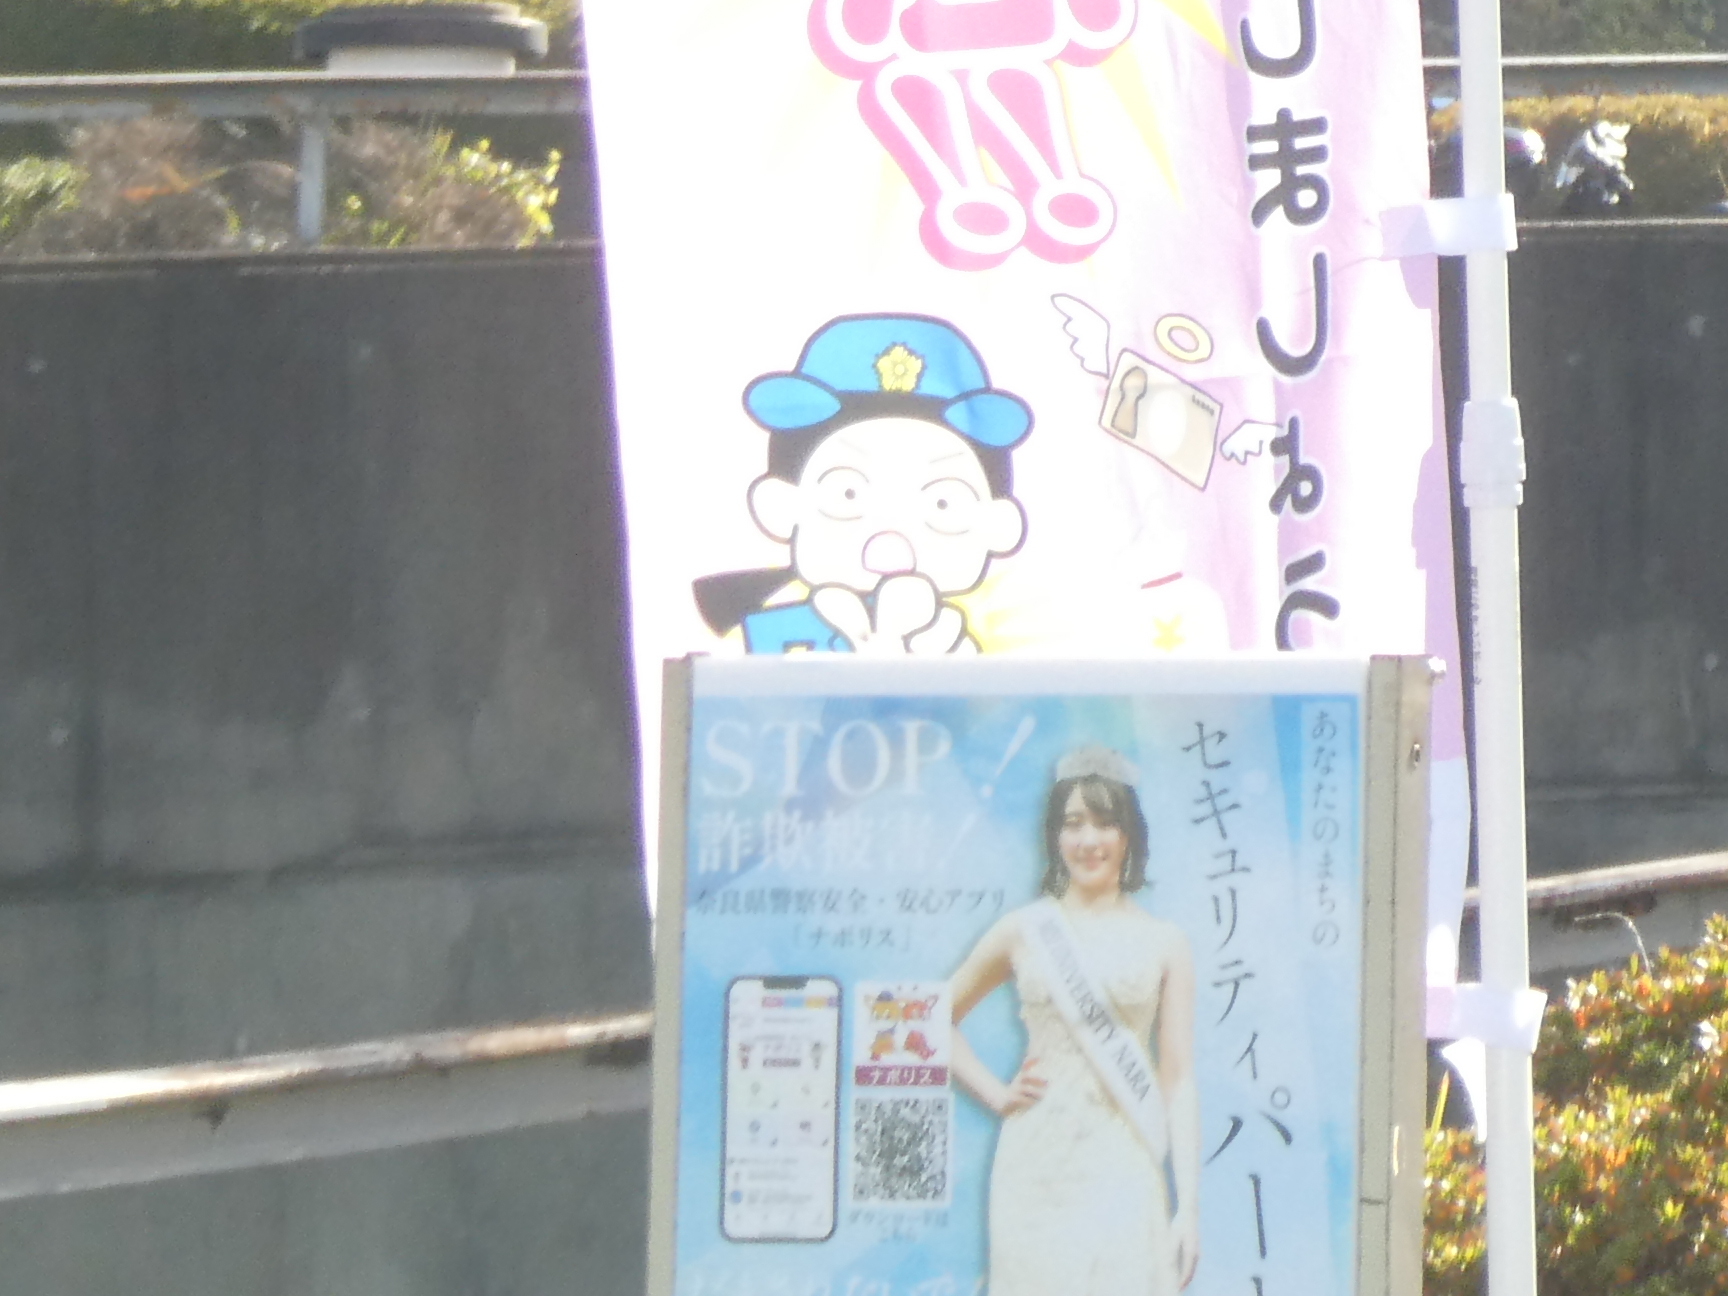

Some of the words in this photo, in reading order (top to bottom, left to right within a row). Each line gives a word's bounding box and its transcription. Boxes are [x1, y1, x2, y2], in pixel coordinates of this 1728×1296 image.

[1311, 710, 1340, 949] あなたのまちの
[870, 1069, 932, 1085] ナポリス
[1114, 1044, 1151, 1102] NARA
